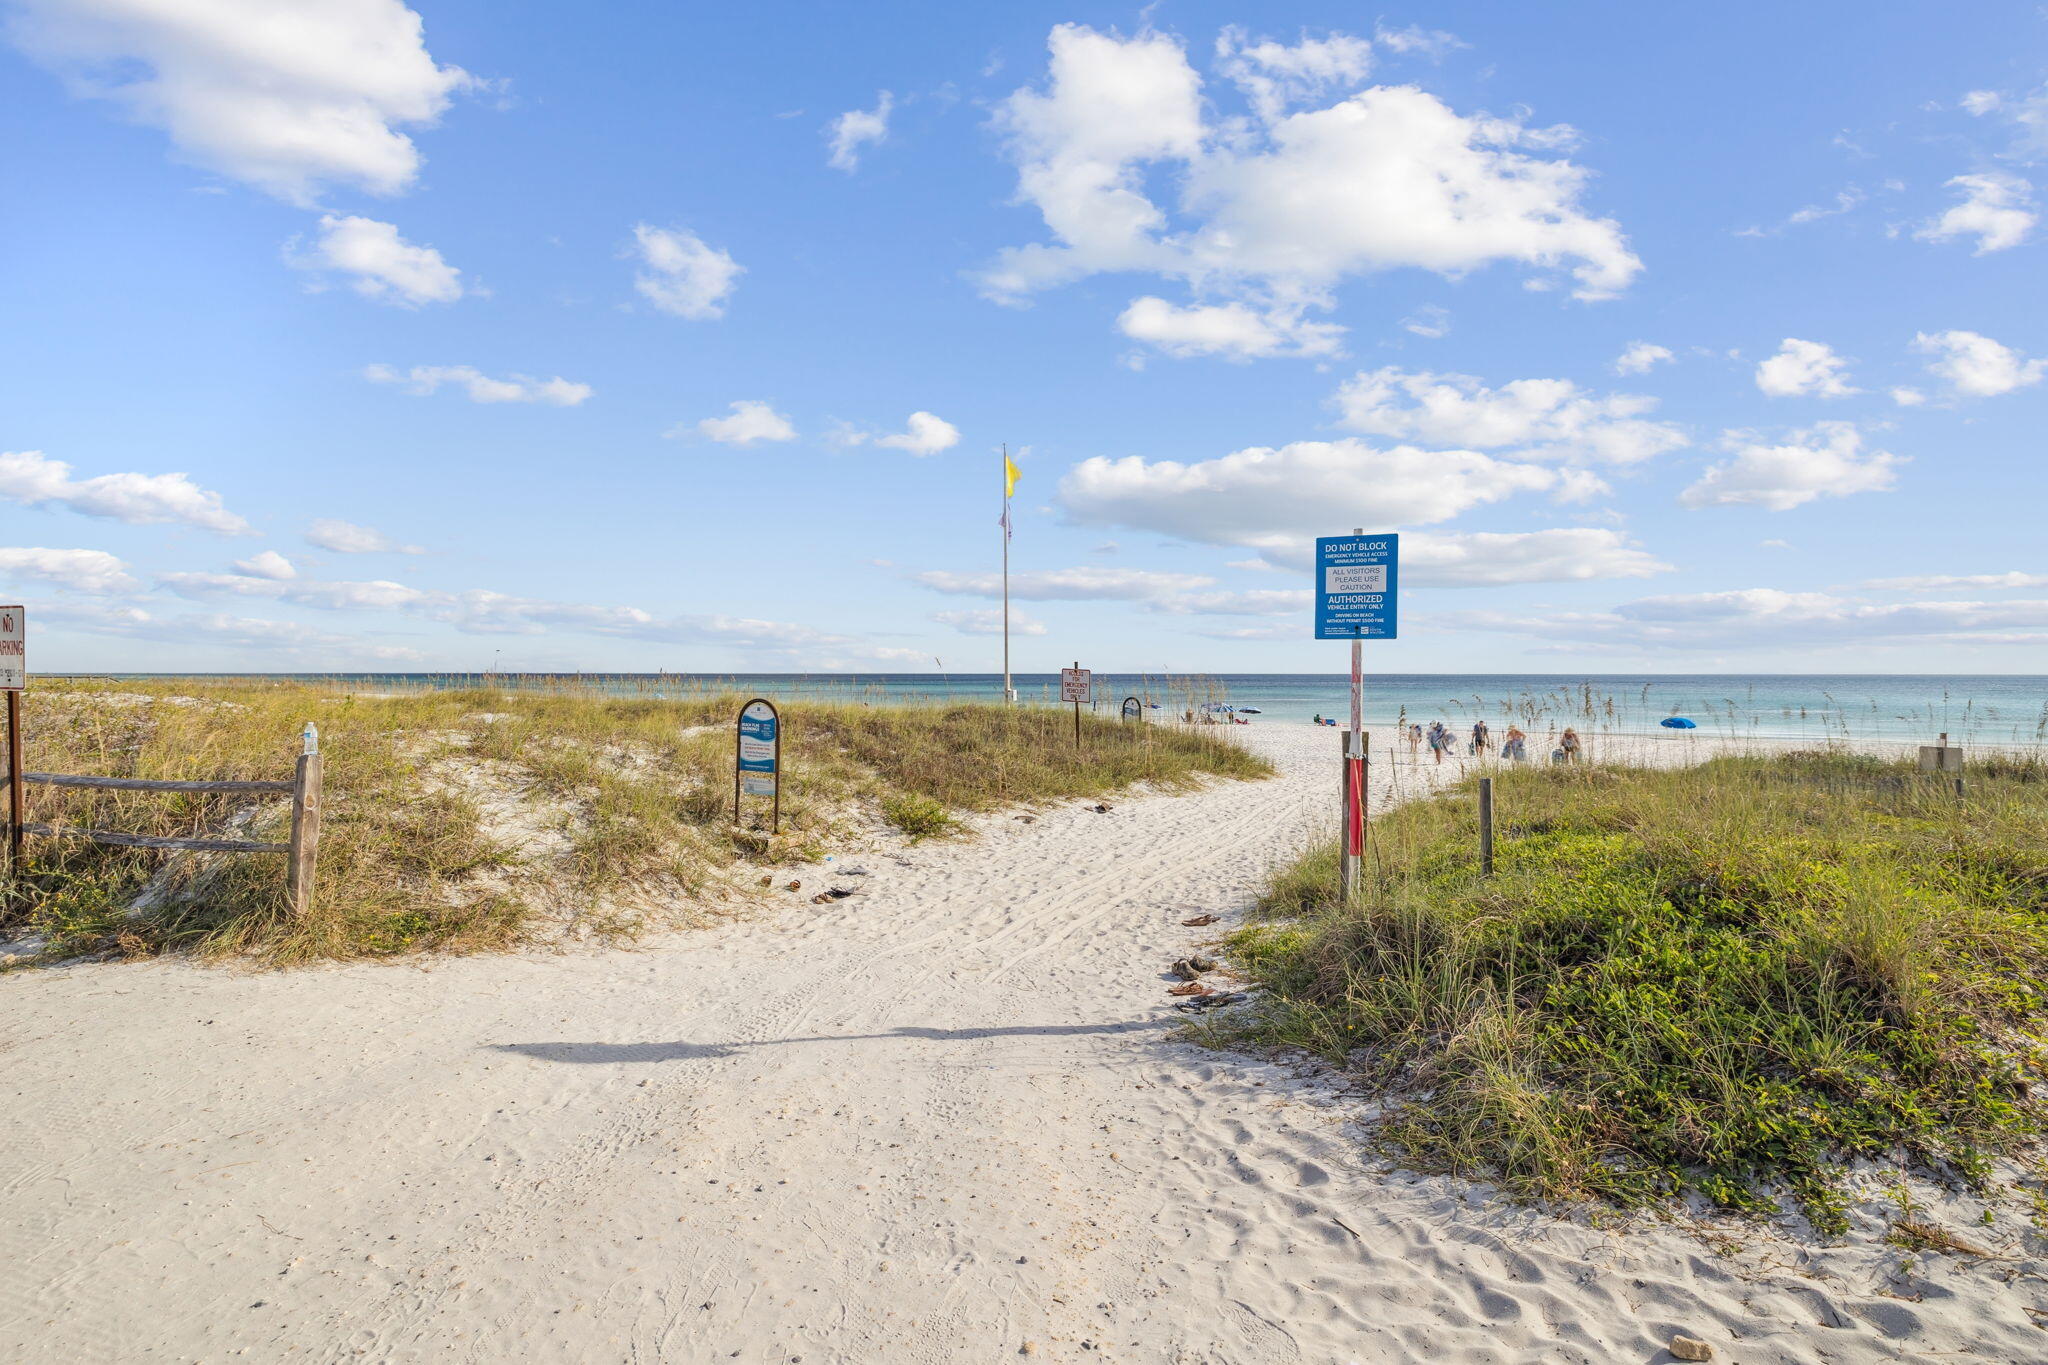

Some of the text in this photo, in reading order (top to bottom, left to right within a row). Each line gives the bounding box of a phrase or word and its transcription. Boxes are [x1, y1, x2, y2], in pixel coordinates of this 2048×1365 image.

[1325, 541, 1387, 552] DO NOT BLOCK
[1346, 567, 1380, 575] VISITORS
[1328, 595, 1383, 603] AUTHORIZED
[3, 617, 14, 633] NO
